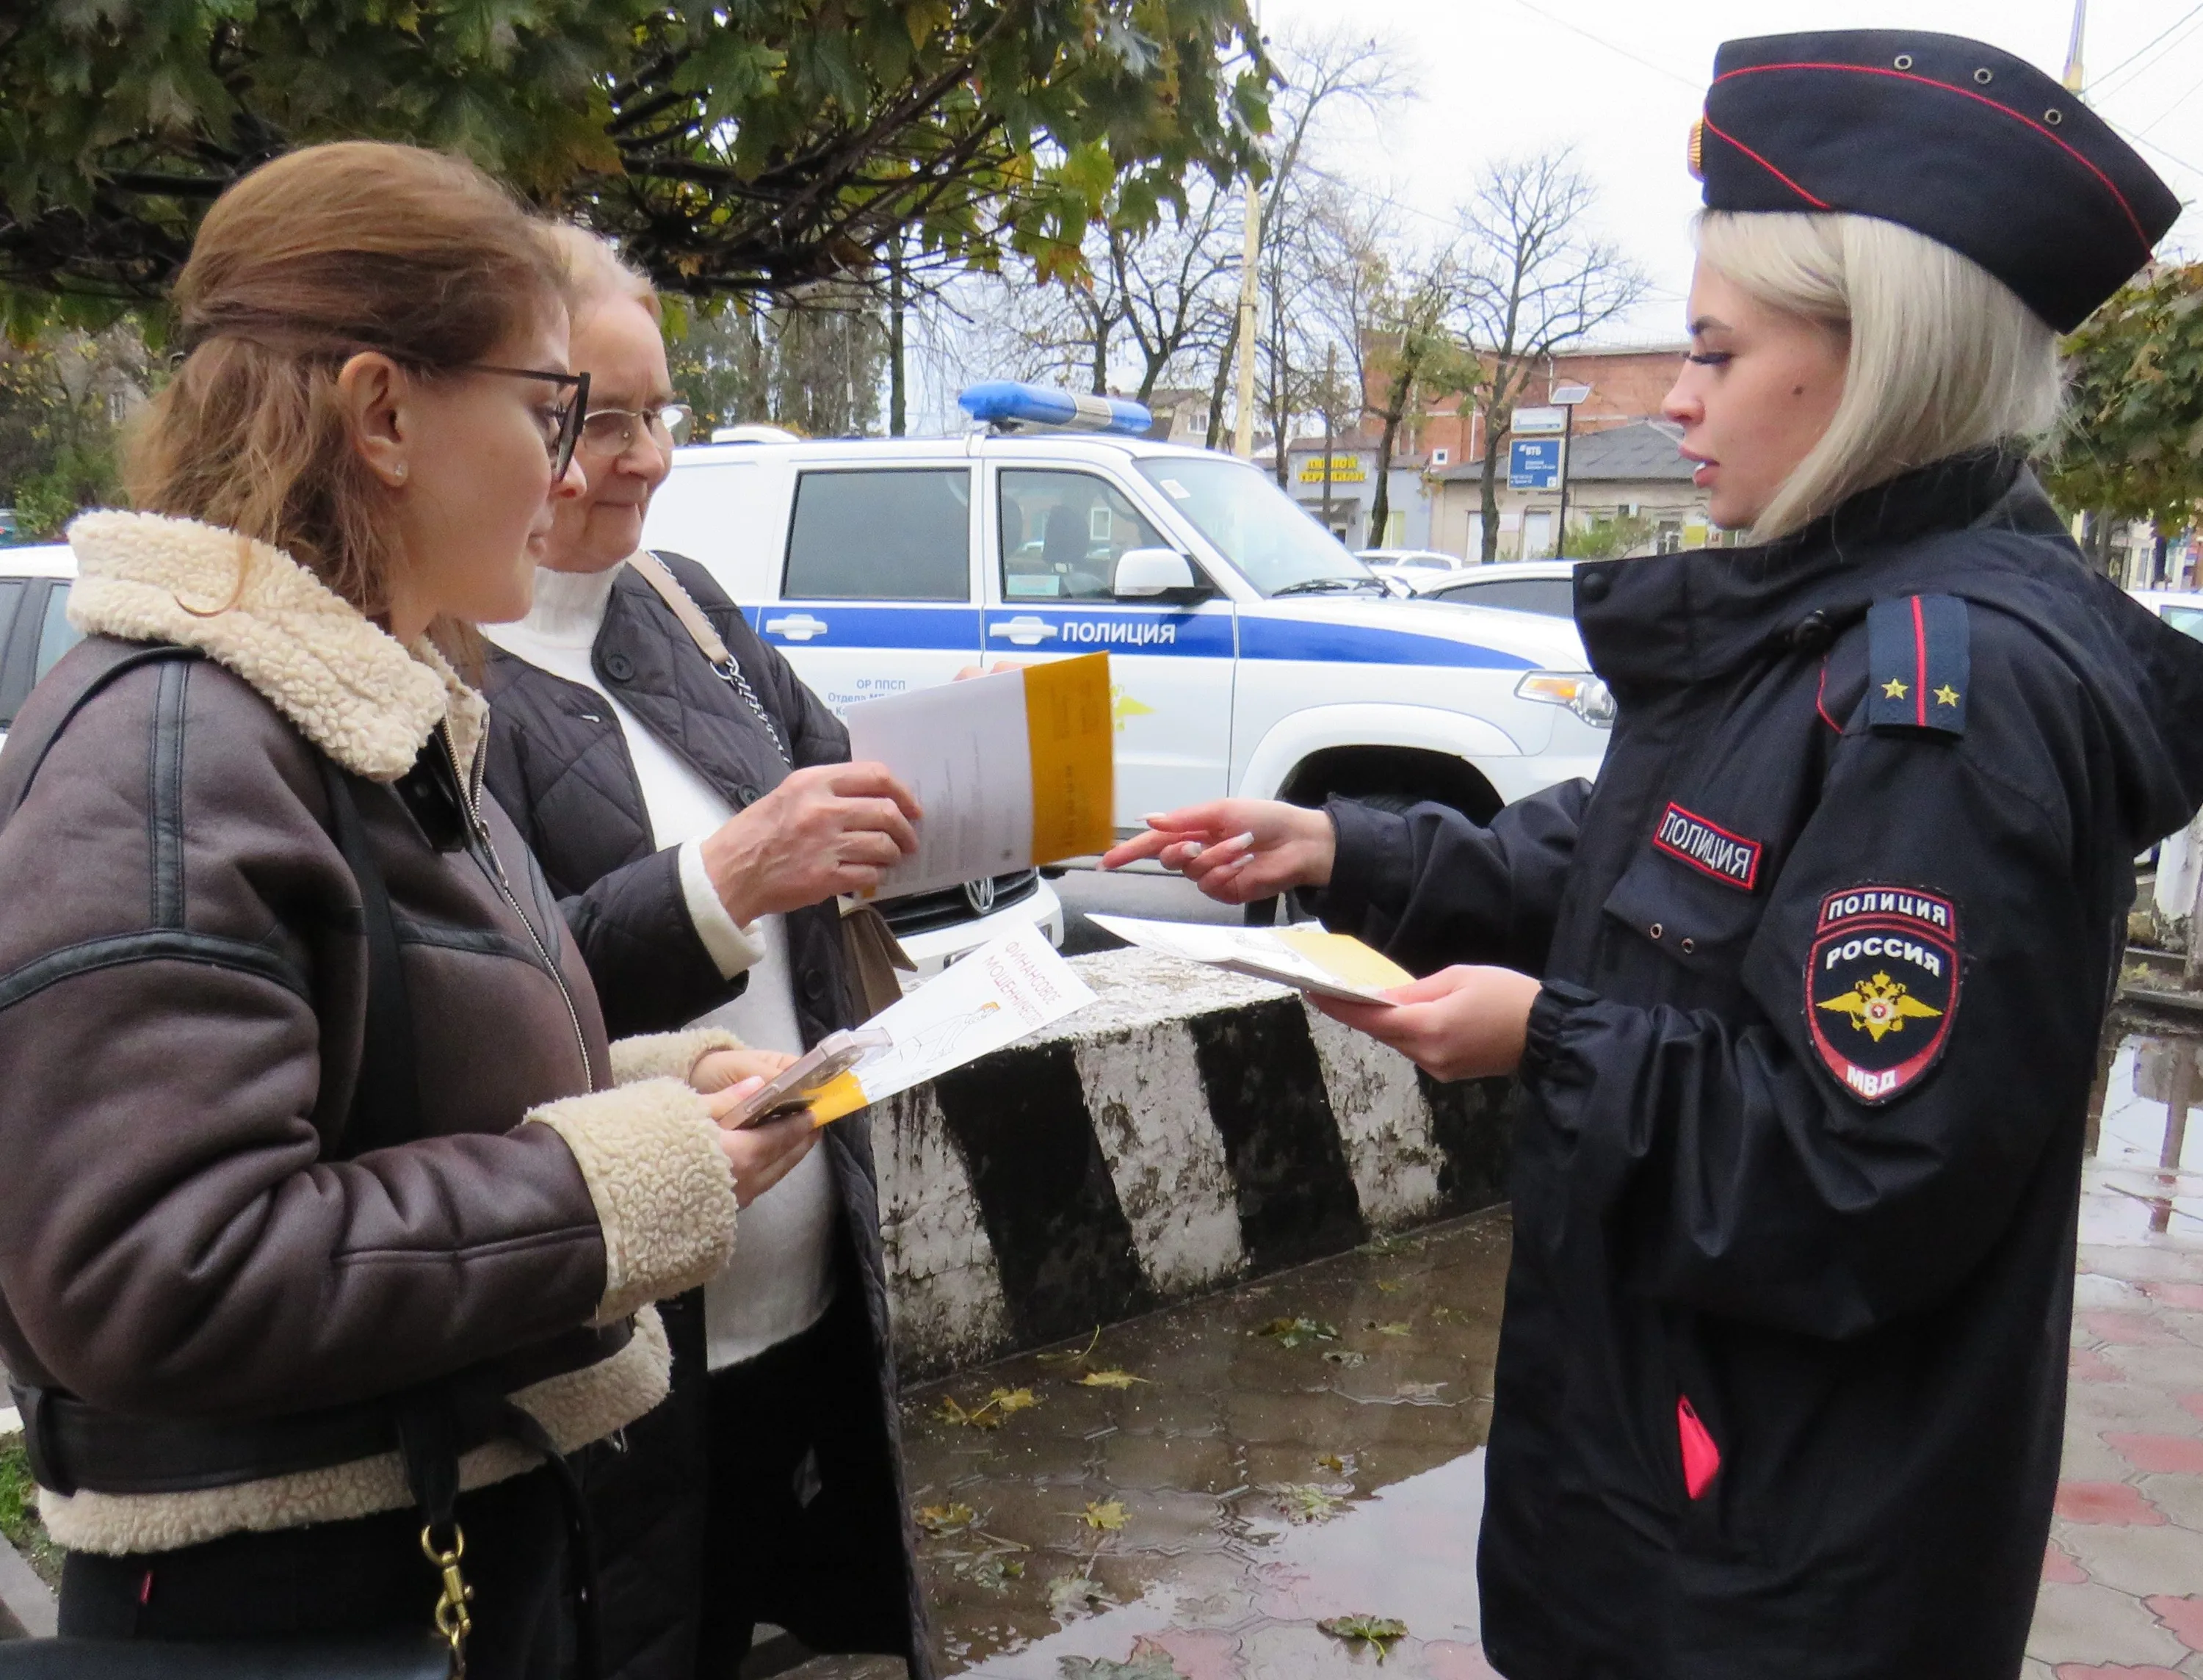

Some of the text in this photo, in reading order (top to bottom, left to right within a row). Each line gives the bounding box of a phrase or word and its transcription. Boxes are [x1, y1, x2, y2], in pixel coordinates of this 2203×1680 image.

[1063, 622, 1176, 646] ПОЛИЦИЯ
[856, 679, 905, 690] ОР ППСП
[1659, 811, 1751, 879] ПОЛИЦИЯ
[1828, 892, 1947, 927] ПОЛИЦИЯ
[1005, 941, 1063, 1006] ФИНАНСОВОЕ
[1826, 936, 1941, 977] РОССИЯ
[1846, 1064, 1897, 1096] МВД
